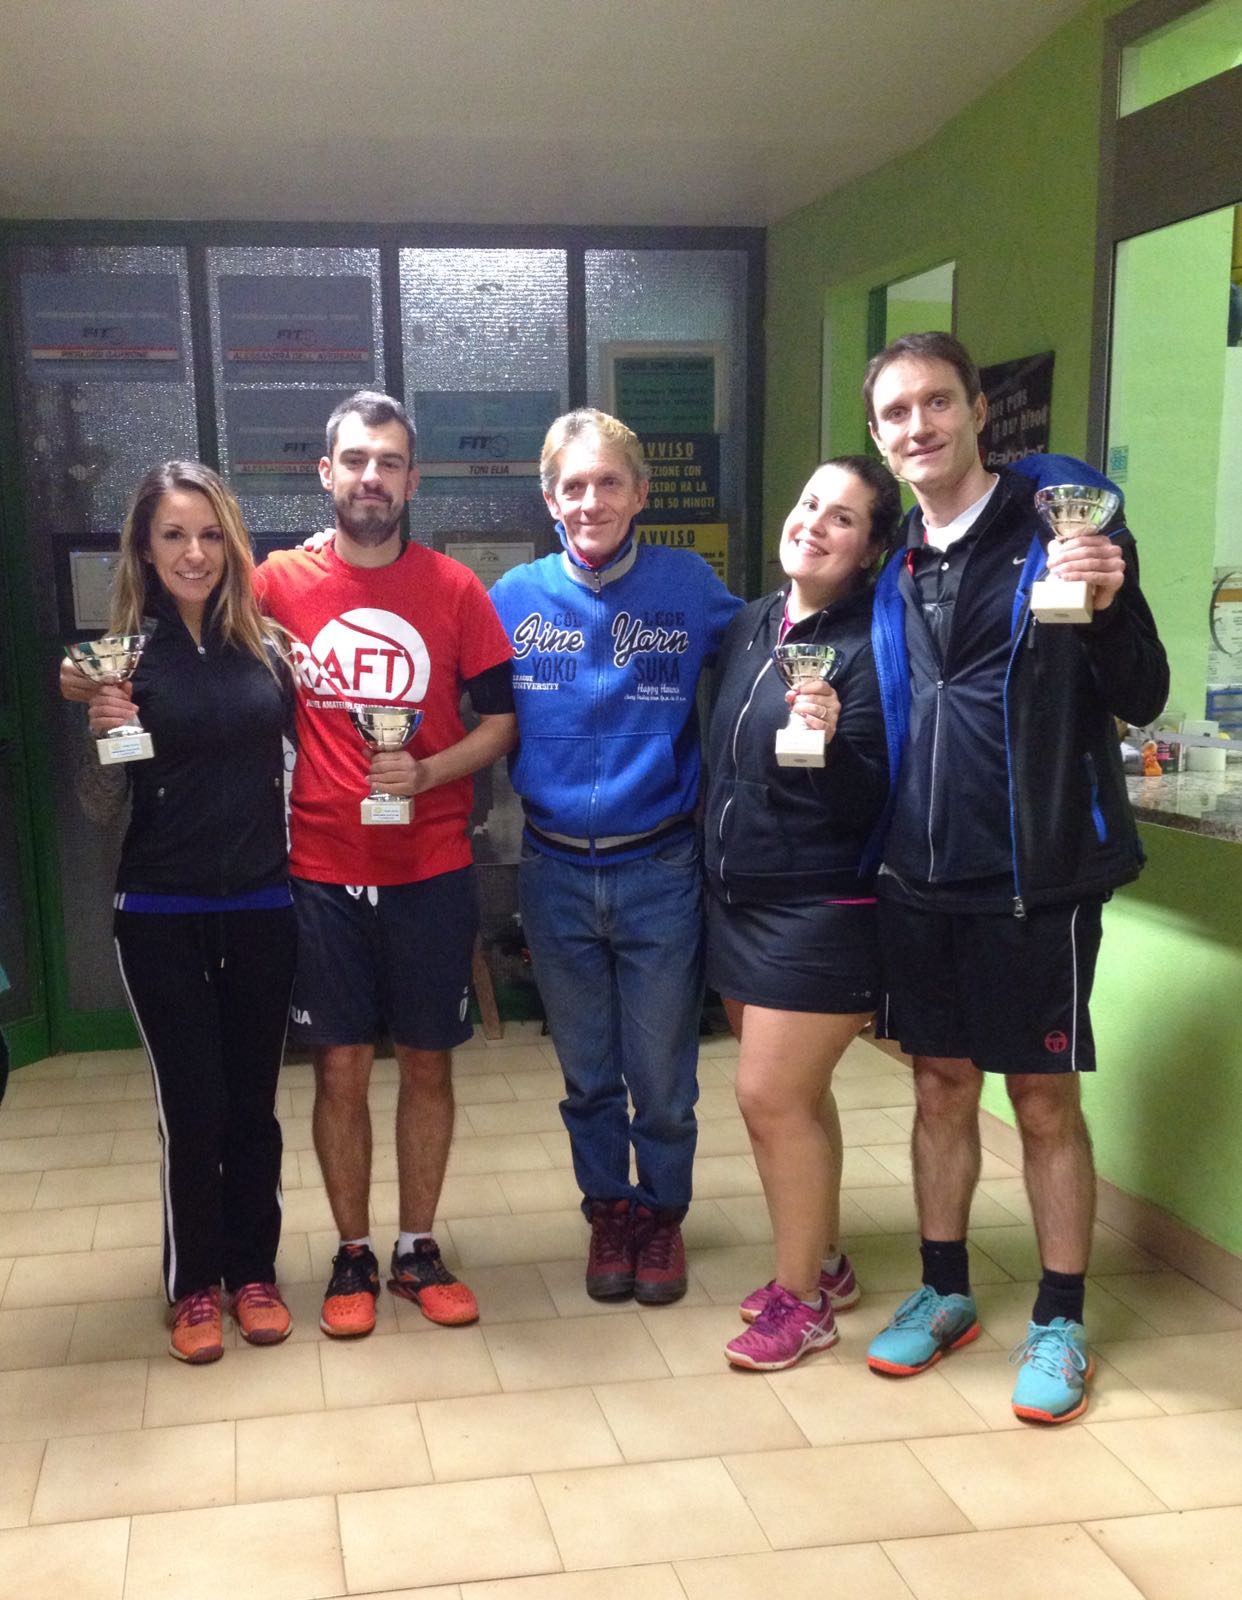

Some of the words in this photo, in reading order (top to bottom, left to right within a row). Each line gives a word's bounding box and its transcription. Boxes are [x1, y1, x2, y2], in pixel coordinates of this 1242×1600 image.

[283, 442, 309, 452] FIT
[459, 436, 491, 449] FIT
[470, 465, 489, 474] TONI
[491, 465, 509, 474] ELIA
[684, 465, 702, 477] CON
[681, 481, 692, 492] HA
[696, 481, 707, 492] LA
[668, 497, 679, 509] 50
[683, 497, 715, 508] MINUTI
[640, 530, 695, 545] AVVISO
[612, 611, 689, 667] Yarn
[531, 657, 577, 683] YOKO
[633, 656, 681, 683] SUKA
[512, 682, 560, 691] UNIVERSITY
[637, 683, 659, 695] Happy
